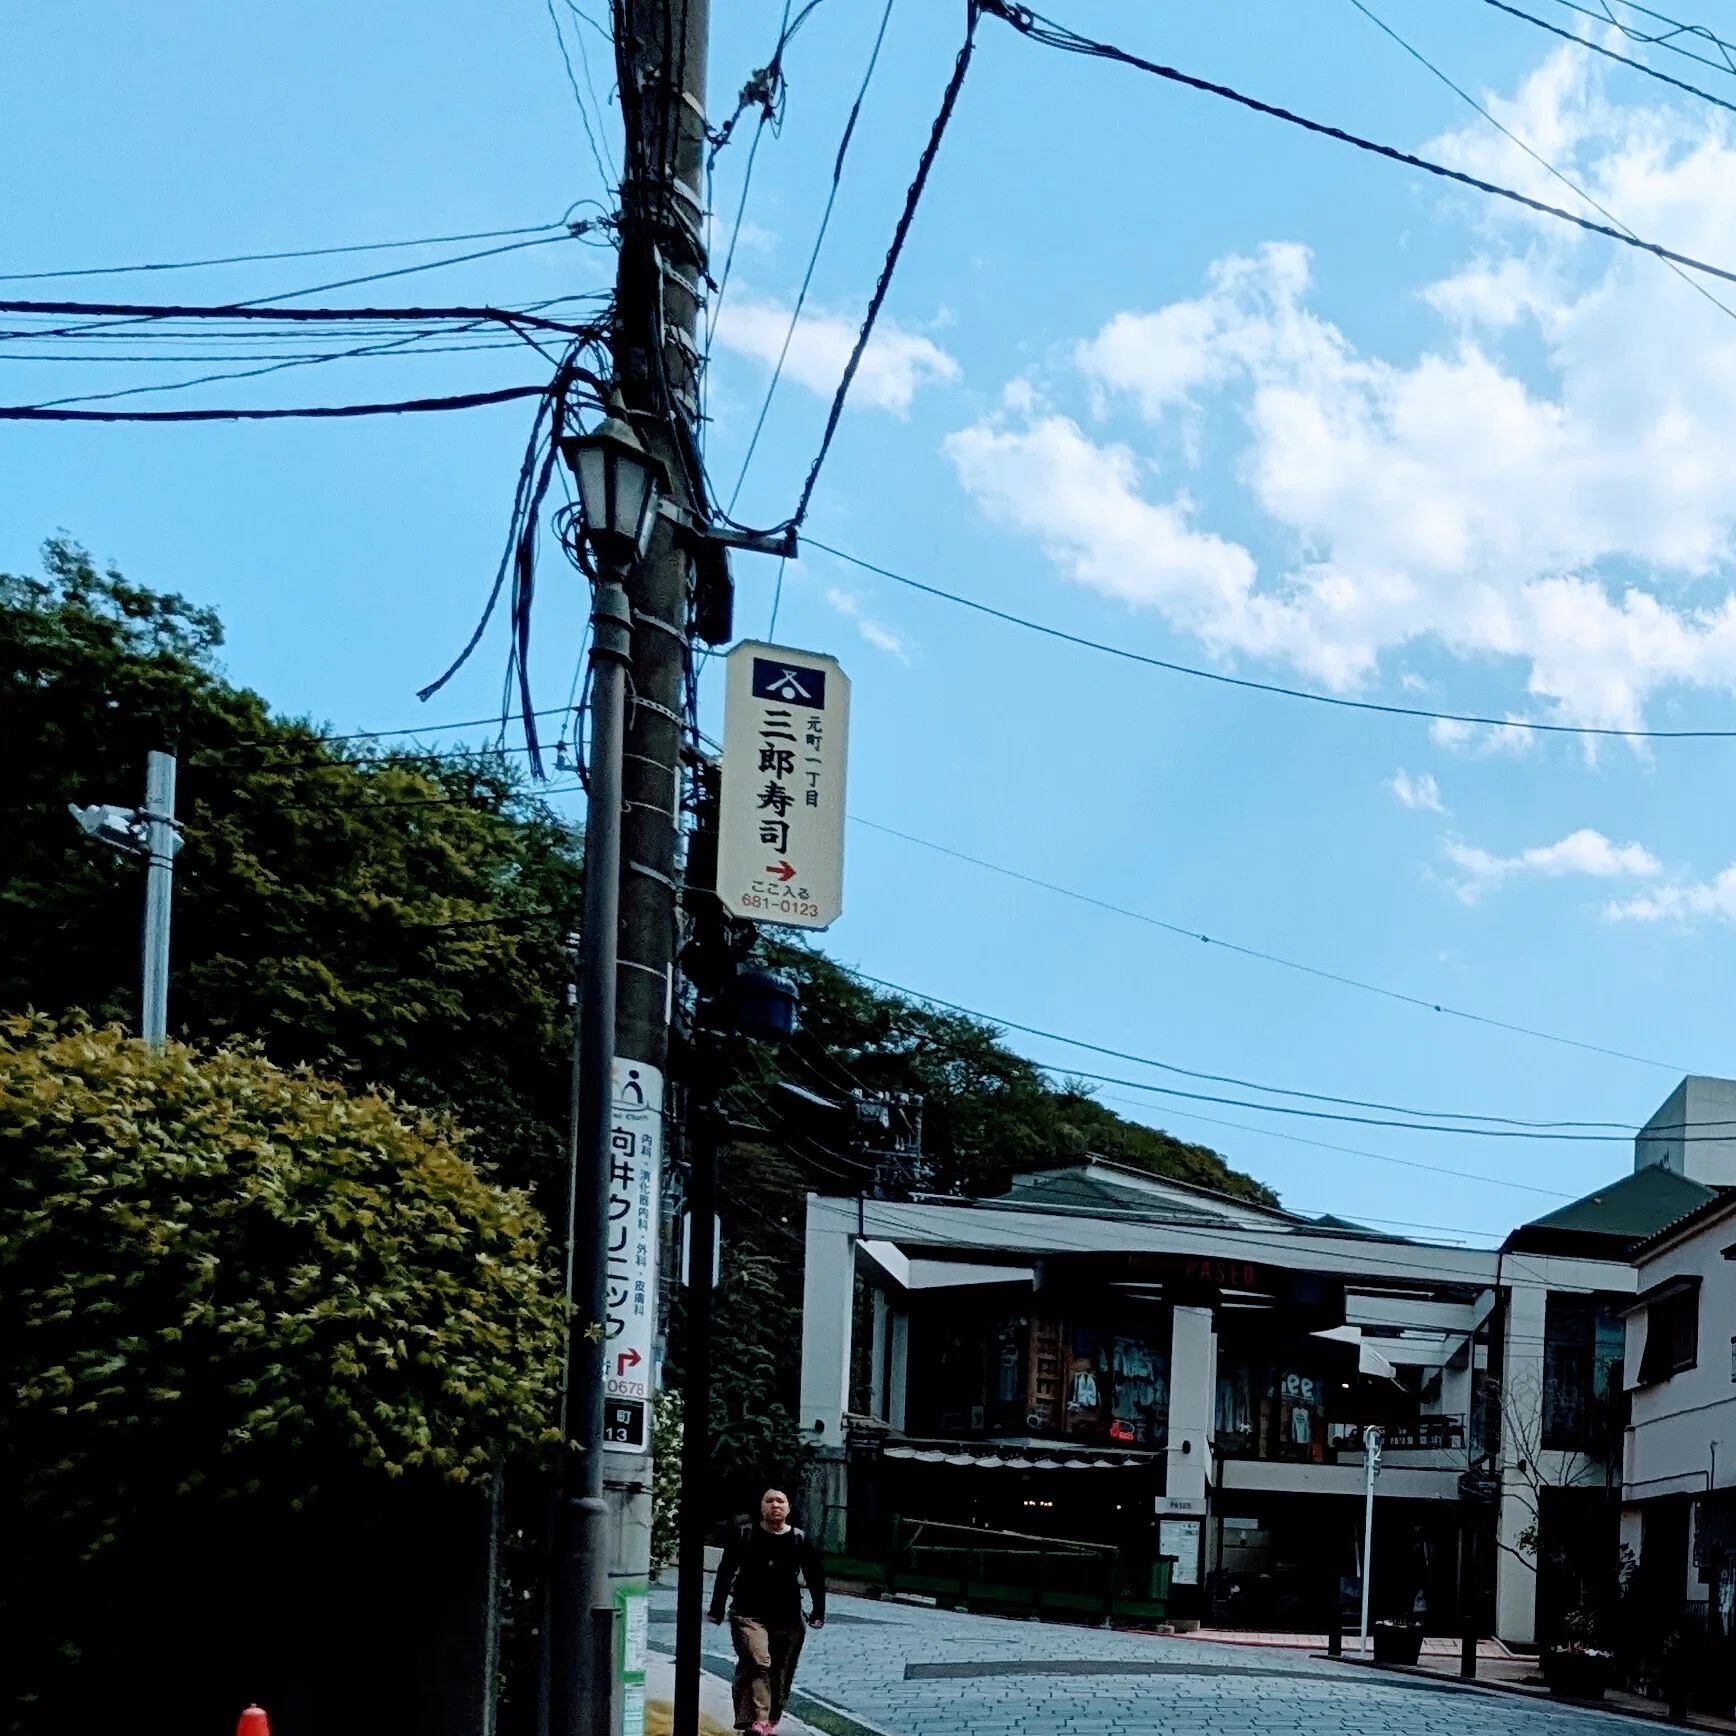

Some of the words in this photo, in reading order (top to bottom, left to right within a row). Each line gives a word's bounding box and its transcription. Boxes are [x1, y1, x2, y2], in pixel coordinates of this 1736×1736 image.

[804, 715, 823, 808] 元町一丁目
[756, 709, 798, 855] 三郎寿司
[751, 880, 810, 900] ここ入る
[741, 894, 819, 918] 681-0123
[607, 1379, 644, 1396] 0678
